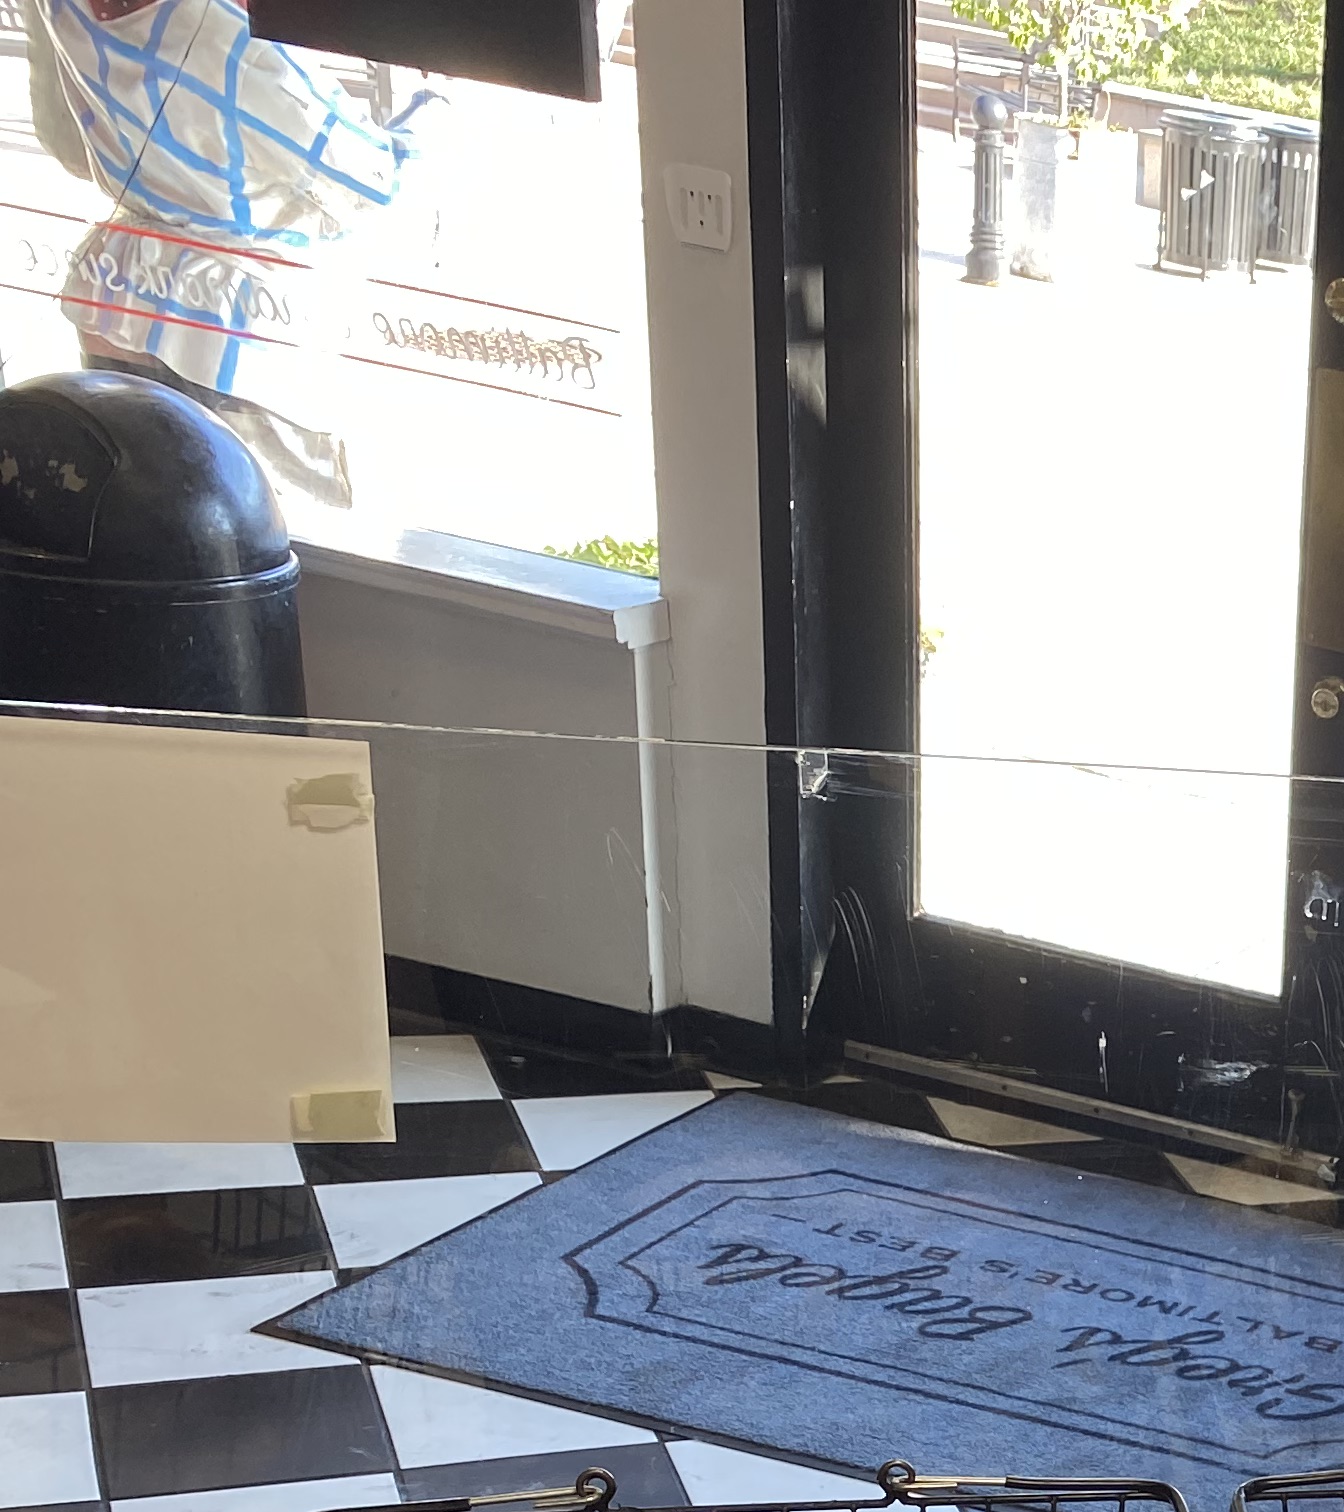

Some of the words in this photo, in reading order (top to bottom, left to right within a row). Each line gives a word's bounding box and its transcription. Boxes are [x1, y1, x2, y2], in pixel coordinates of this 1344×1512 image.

[807, 1221, 960, 1263] BEST
[696, 1241, 1034, 1344] Bagels
[978, 1258, 1344, 1355] BALTIMORE'S
